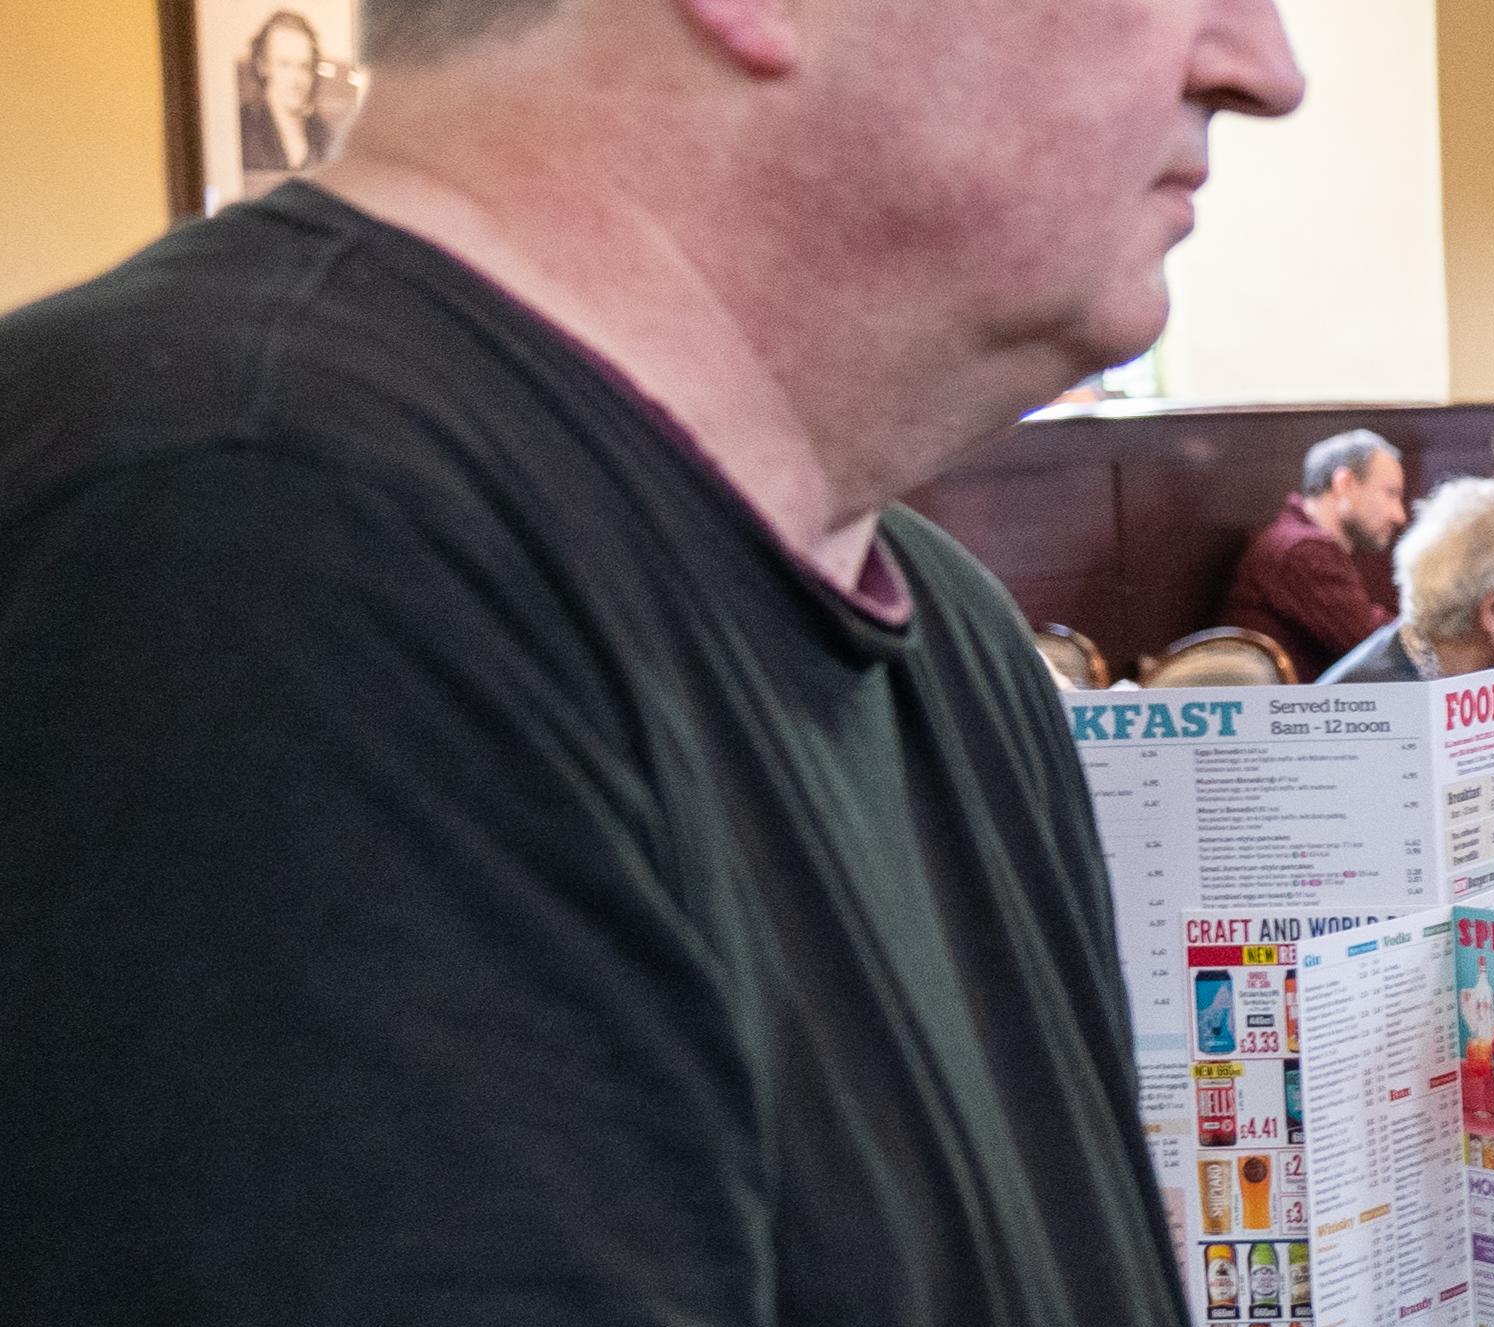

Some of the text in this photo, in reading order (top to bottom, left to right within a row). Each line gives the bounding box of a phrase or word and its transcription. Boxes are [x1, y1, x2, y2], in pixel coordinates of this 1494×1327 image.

[1270, 699, 1331, 714] Served
[1334, 698, 1377, 713] from
[1271, 721, 1311, 736] 8am
[1325, 720, 1342, 735] 12
[1345, 720, 1391, 734] noon
[1447, 785, 1483, 806] Breakfast
[1187, 918, 1251, 943] CRAFT
[1260, 917, 1302, 942] AND
[1247, 946, 1276, 964] NEW
[1240, 1031, 1279, 1053] £3.33
[1194, 1065, 1213, 1077] NEW
[1240, 1116, 1278, 1139] £4.41
[1207, 1163, 1224, 1218] SHIPYARD
